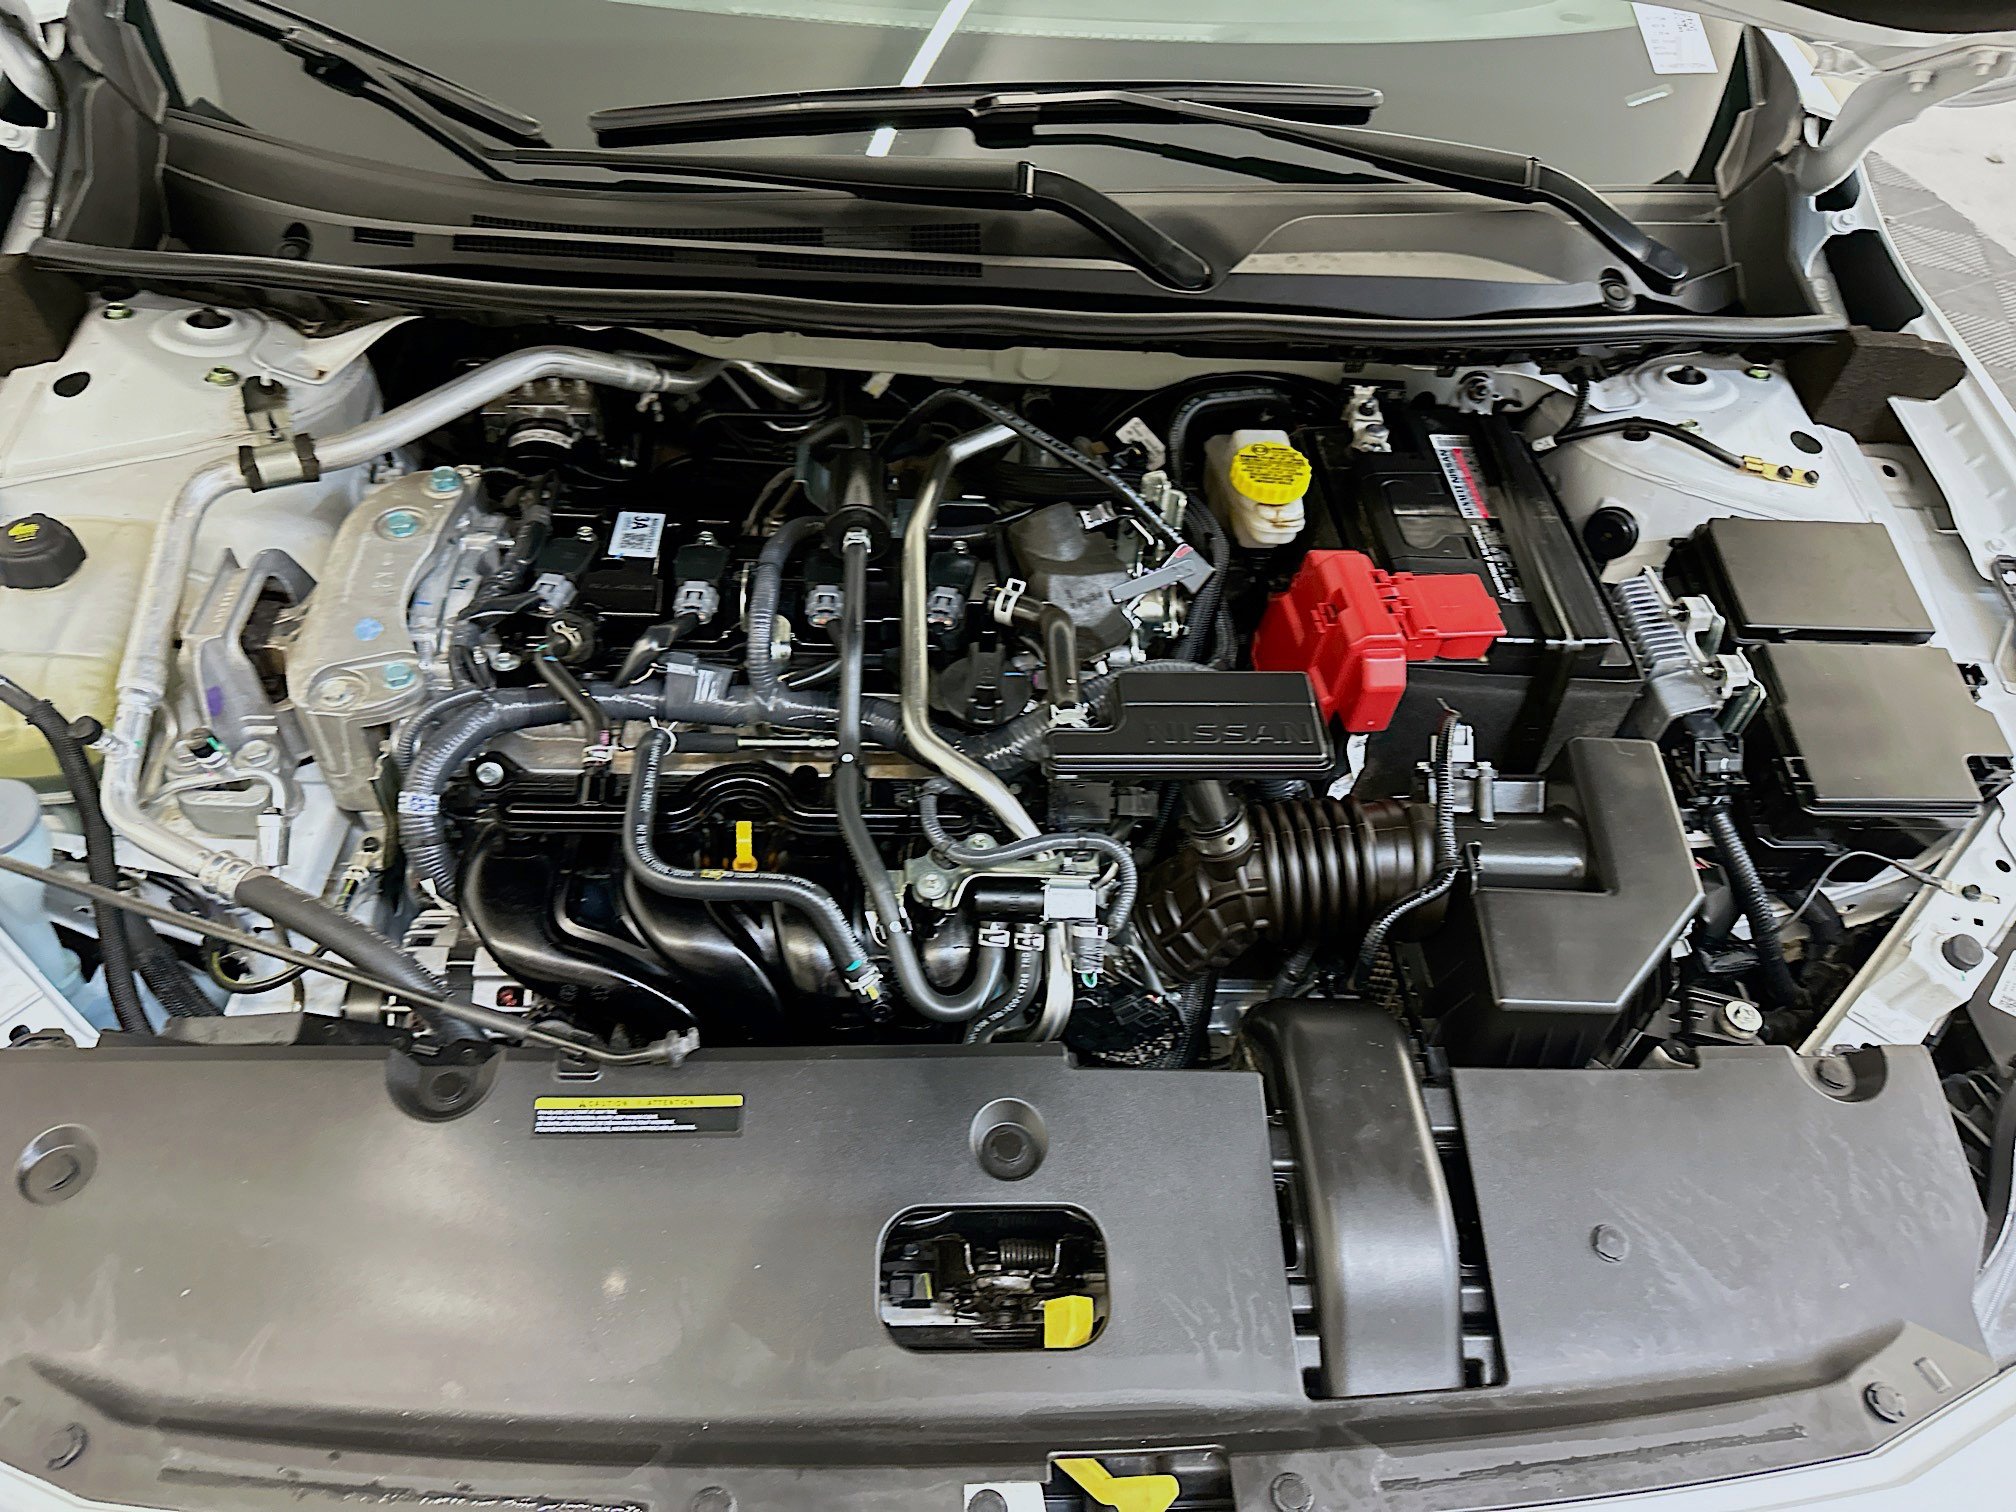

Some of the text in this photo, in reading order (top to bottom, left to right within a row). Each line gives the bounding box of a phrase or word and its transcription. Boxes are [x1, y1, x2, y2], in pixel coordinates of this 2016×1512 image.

[1439, 449, 1459, 486] NISSAN
[631, 516, 651, 530] 3A
[1146, 721, 1315, 745] NISSAN
